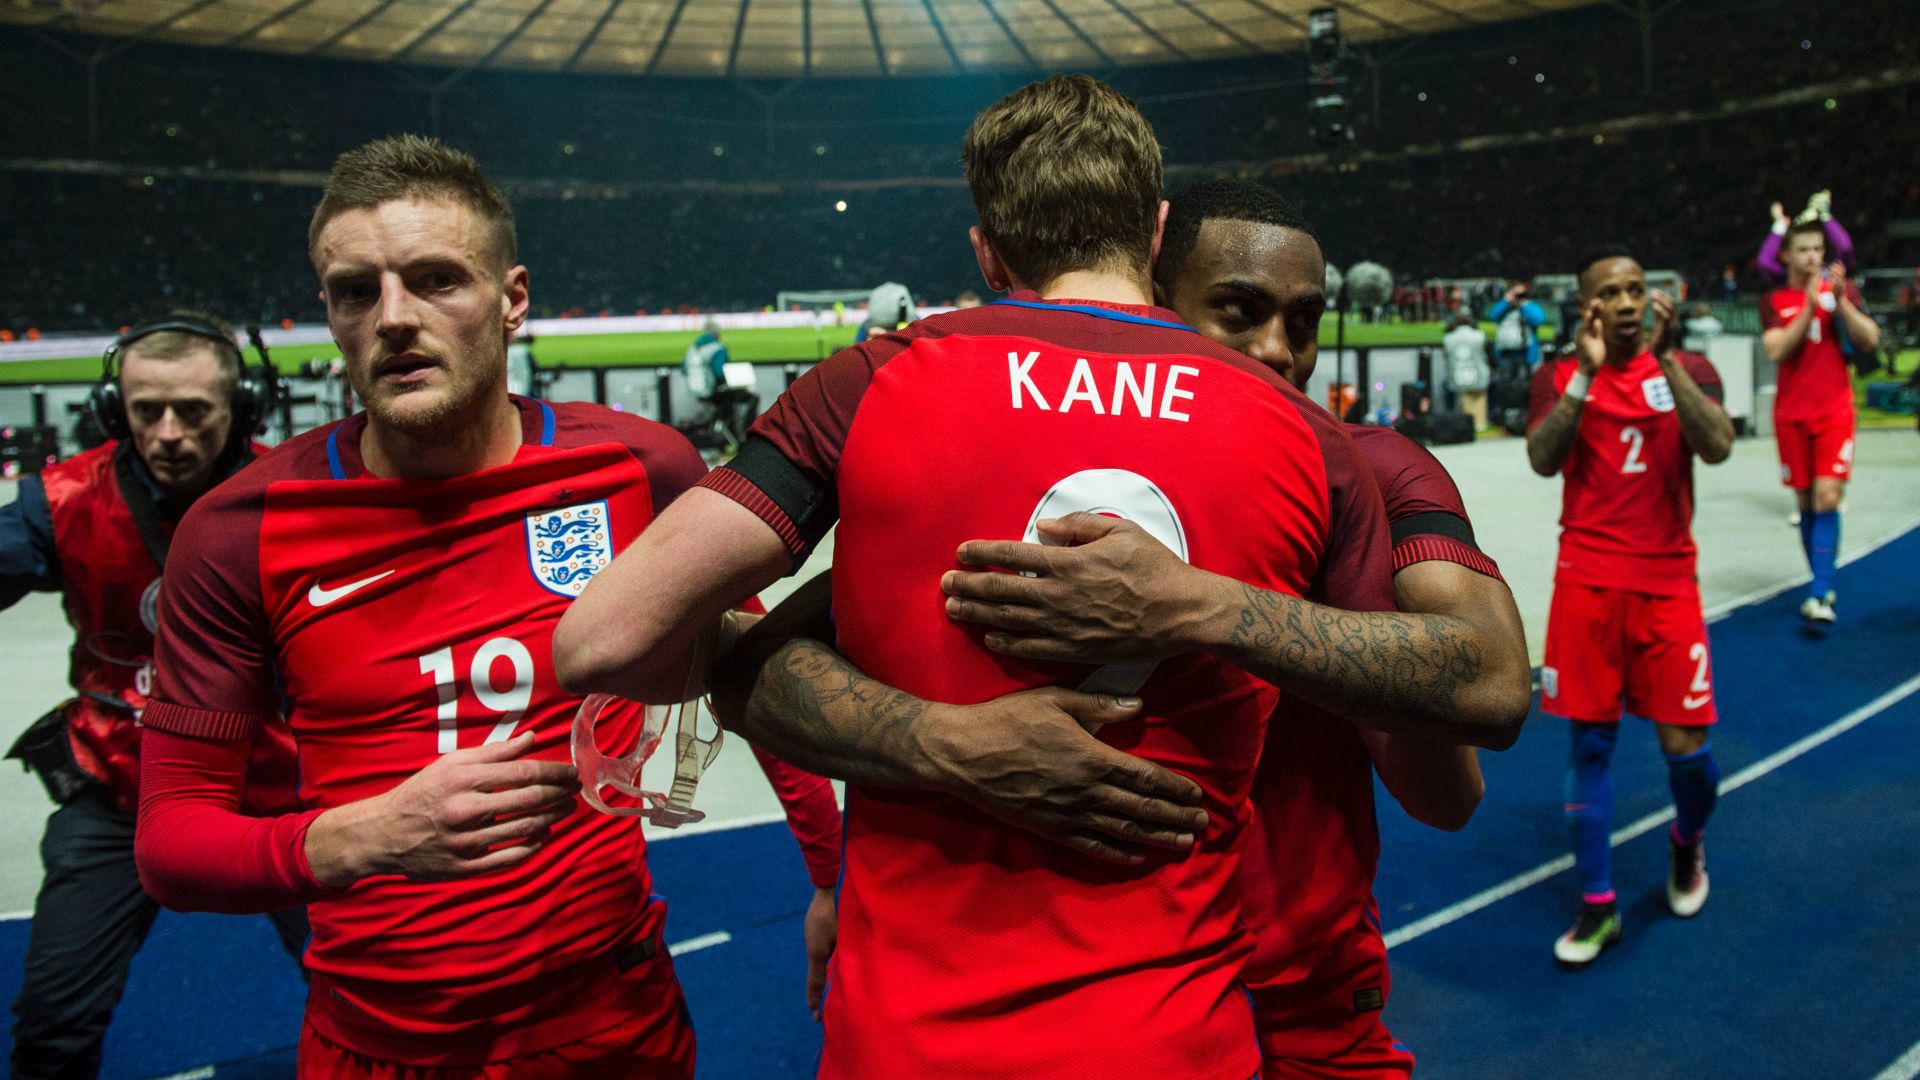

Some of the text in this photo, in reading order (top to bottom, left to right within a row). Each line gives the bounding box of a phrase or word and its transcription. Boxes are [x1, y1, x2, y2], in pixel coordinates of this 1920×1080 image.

[1007, 351, 1200, 423] KANE
[1620, 426, 1647, 473] 2
[418, 636, 534, 754] 19
[1689, 642, 1711, 693] 2
